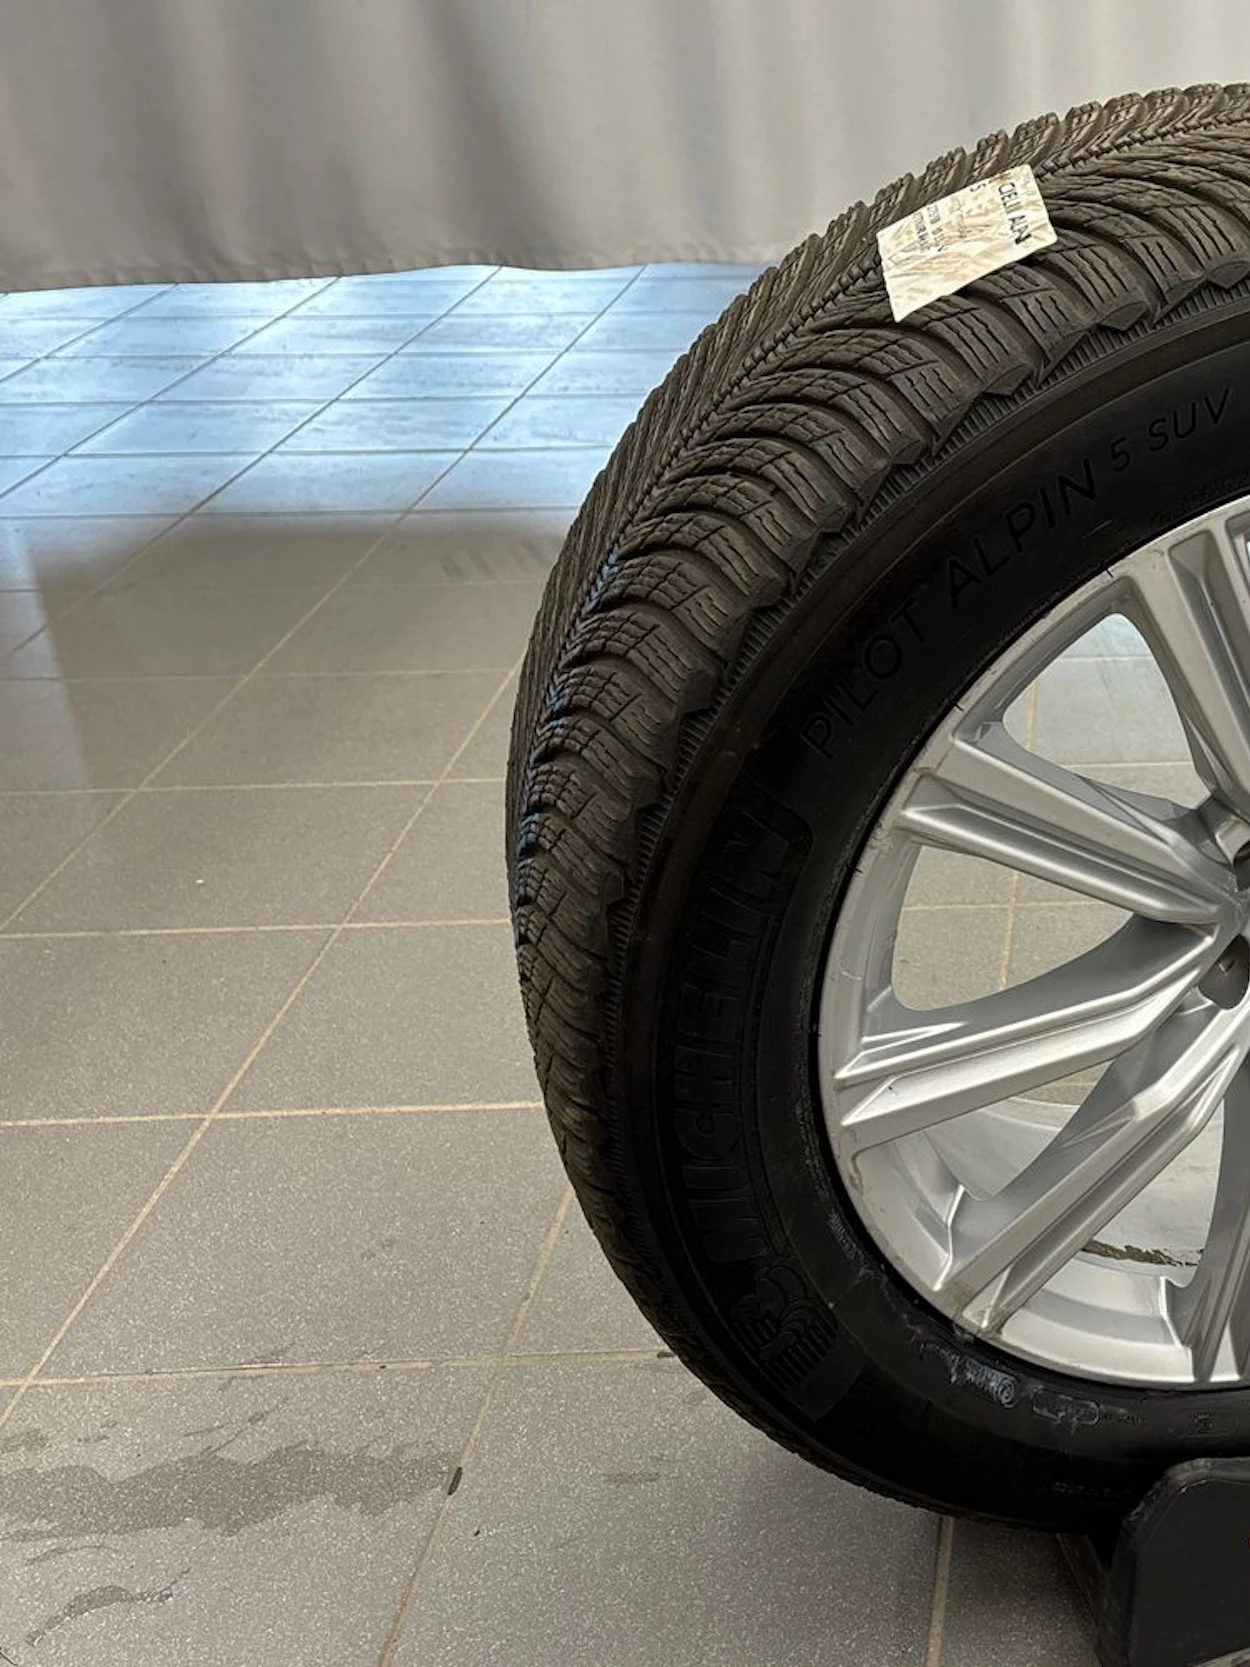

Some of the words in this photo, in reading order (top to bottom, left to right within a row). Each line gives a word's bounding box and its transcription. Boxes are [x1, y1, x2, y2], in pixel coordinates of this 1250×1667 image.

[801, 598, 926, 760] PILOT
[945, 459, 1096, 609] ALPIN
[1110, 438, 1132, 473] 5
[1148, 387, 1231, 453] SUV
[672, 806, 790, 1264] MICHELIN
